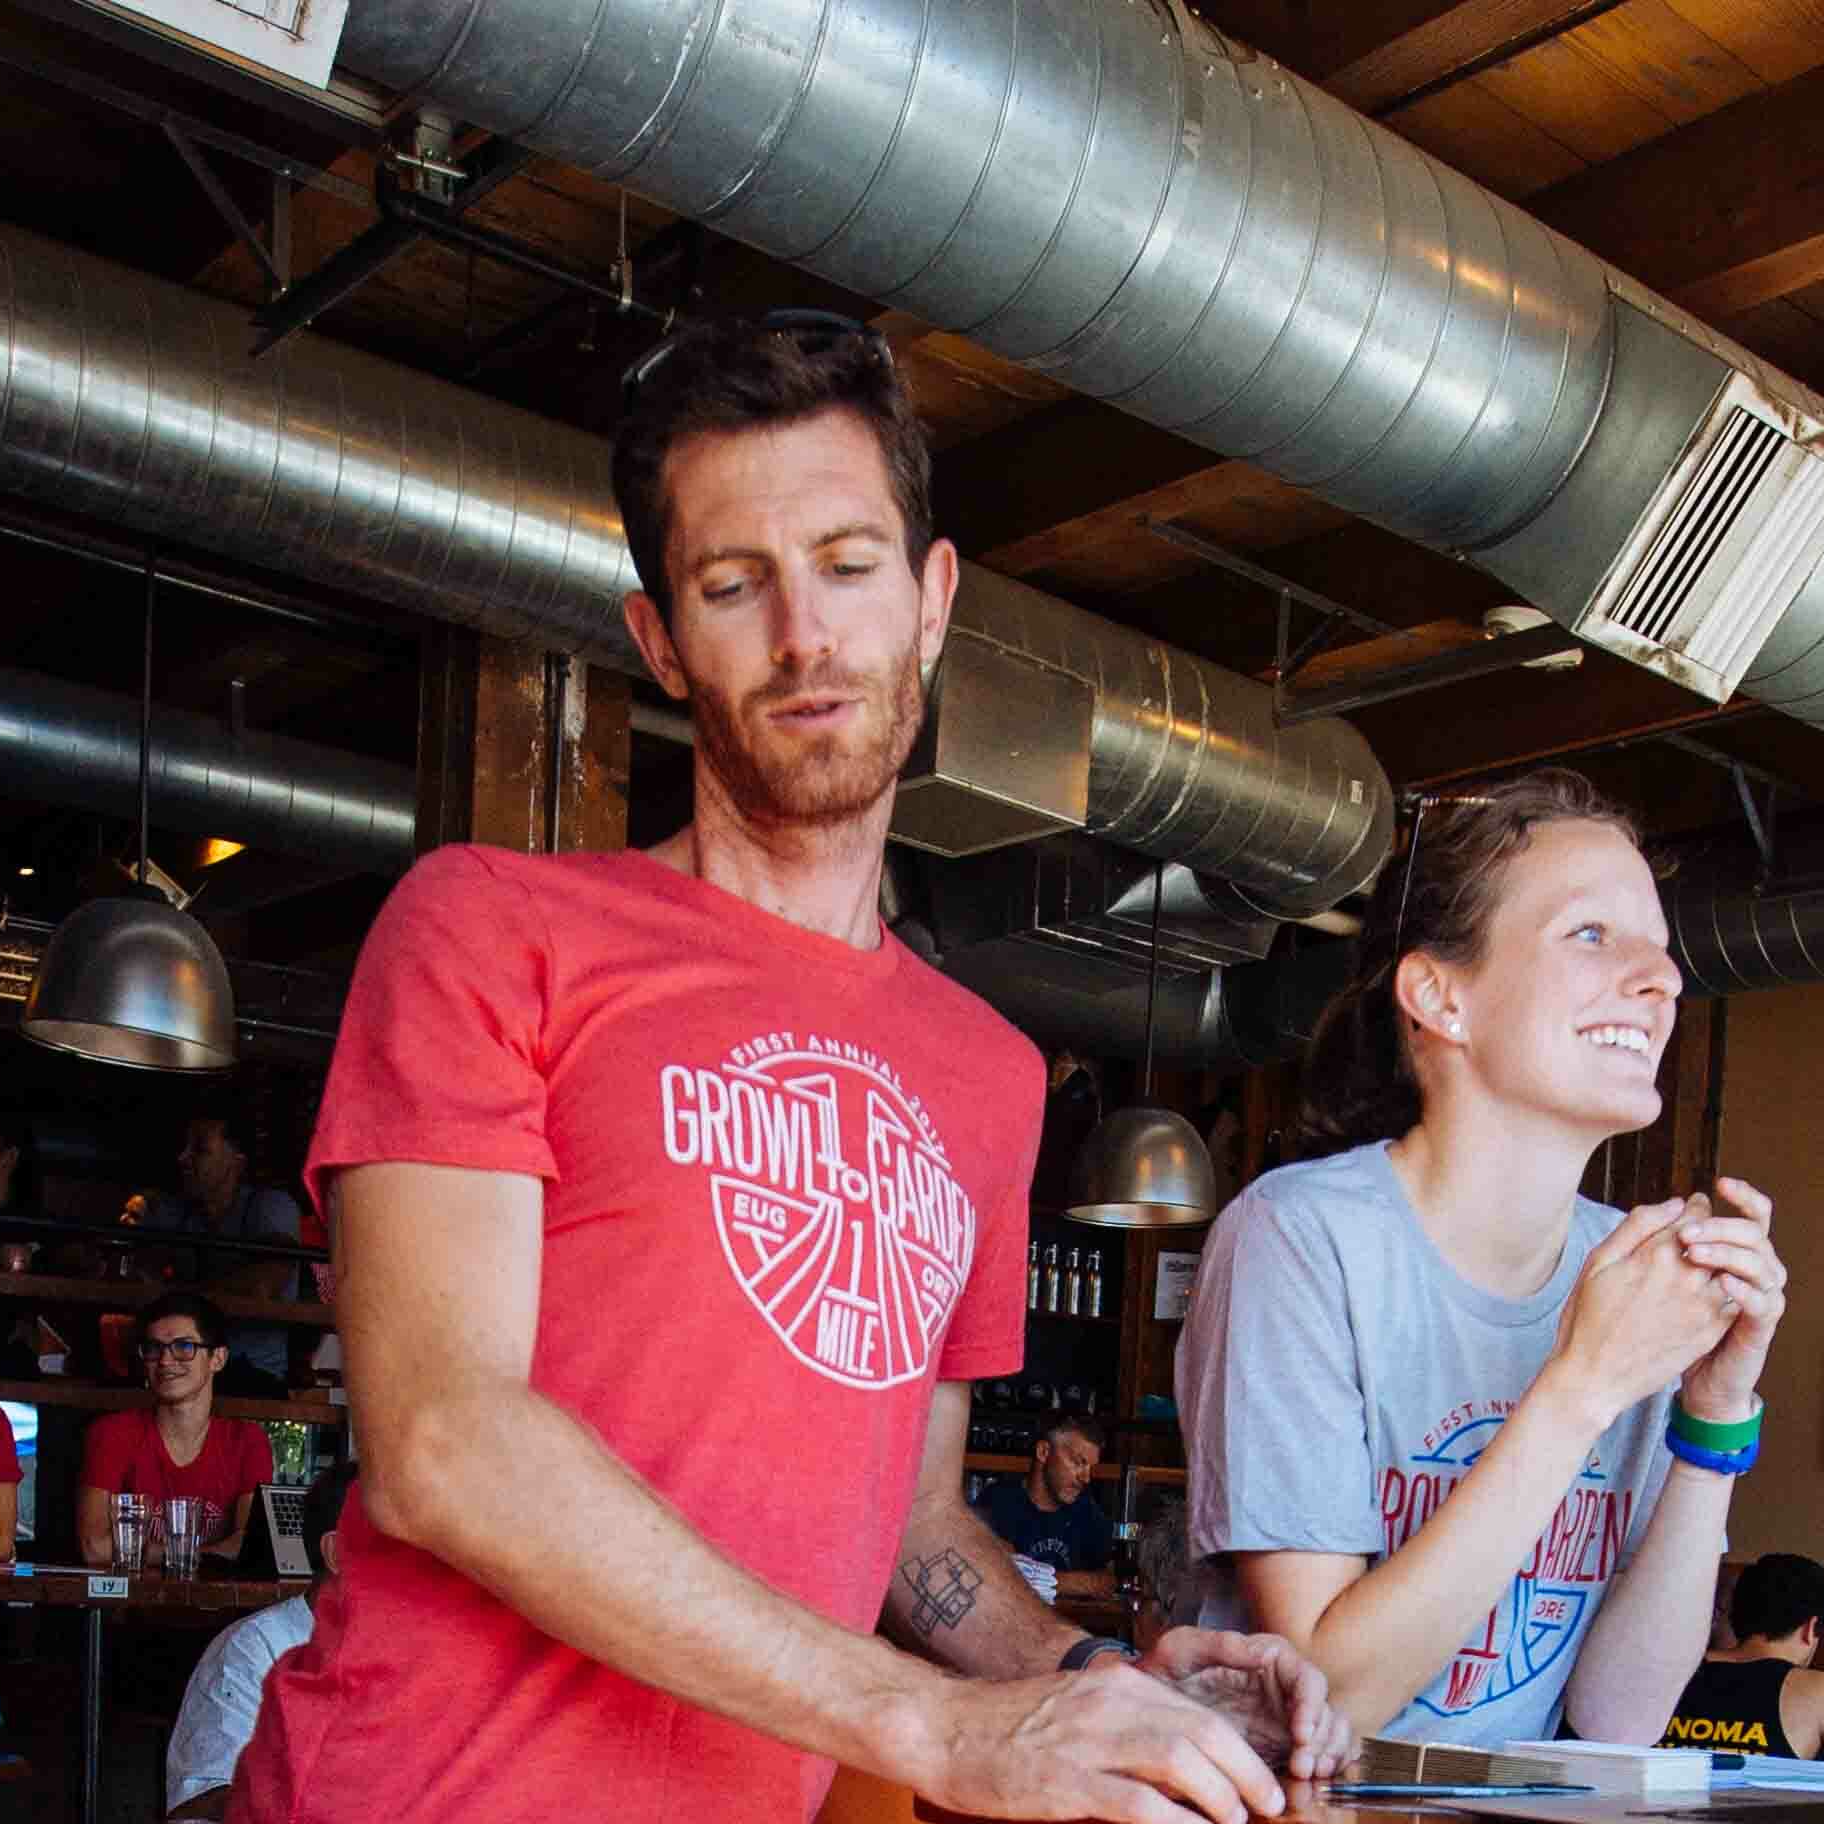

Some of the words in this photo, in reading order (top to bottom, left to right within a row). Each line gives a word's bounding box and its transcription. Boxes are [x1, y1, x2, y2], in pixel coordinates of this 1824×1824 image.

[730, 1031, 796, 1066] FIRST
[808, 1034, 903, 1092] ANNUAL
[733, 1192, 788, 1228] EUG
[815, 1300, 881, 1377] MILE
[1423, 1401, 1473, 1450] FIRST
